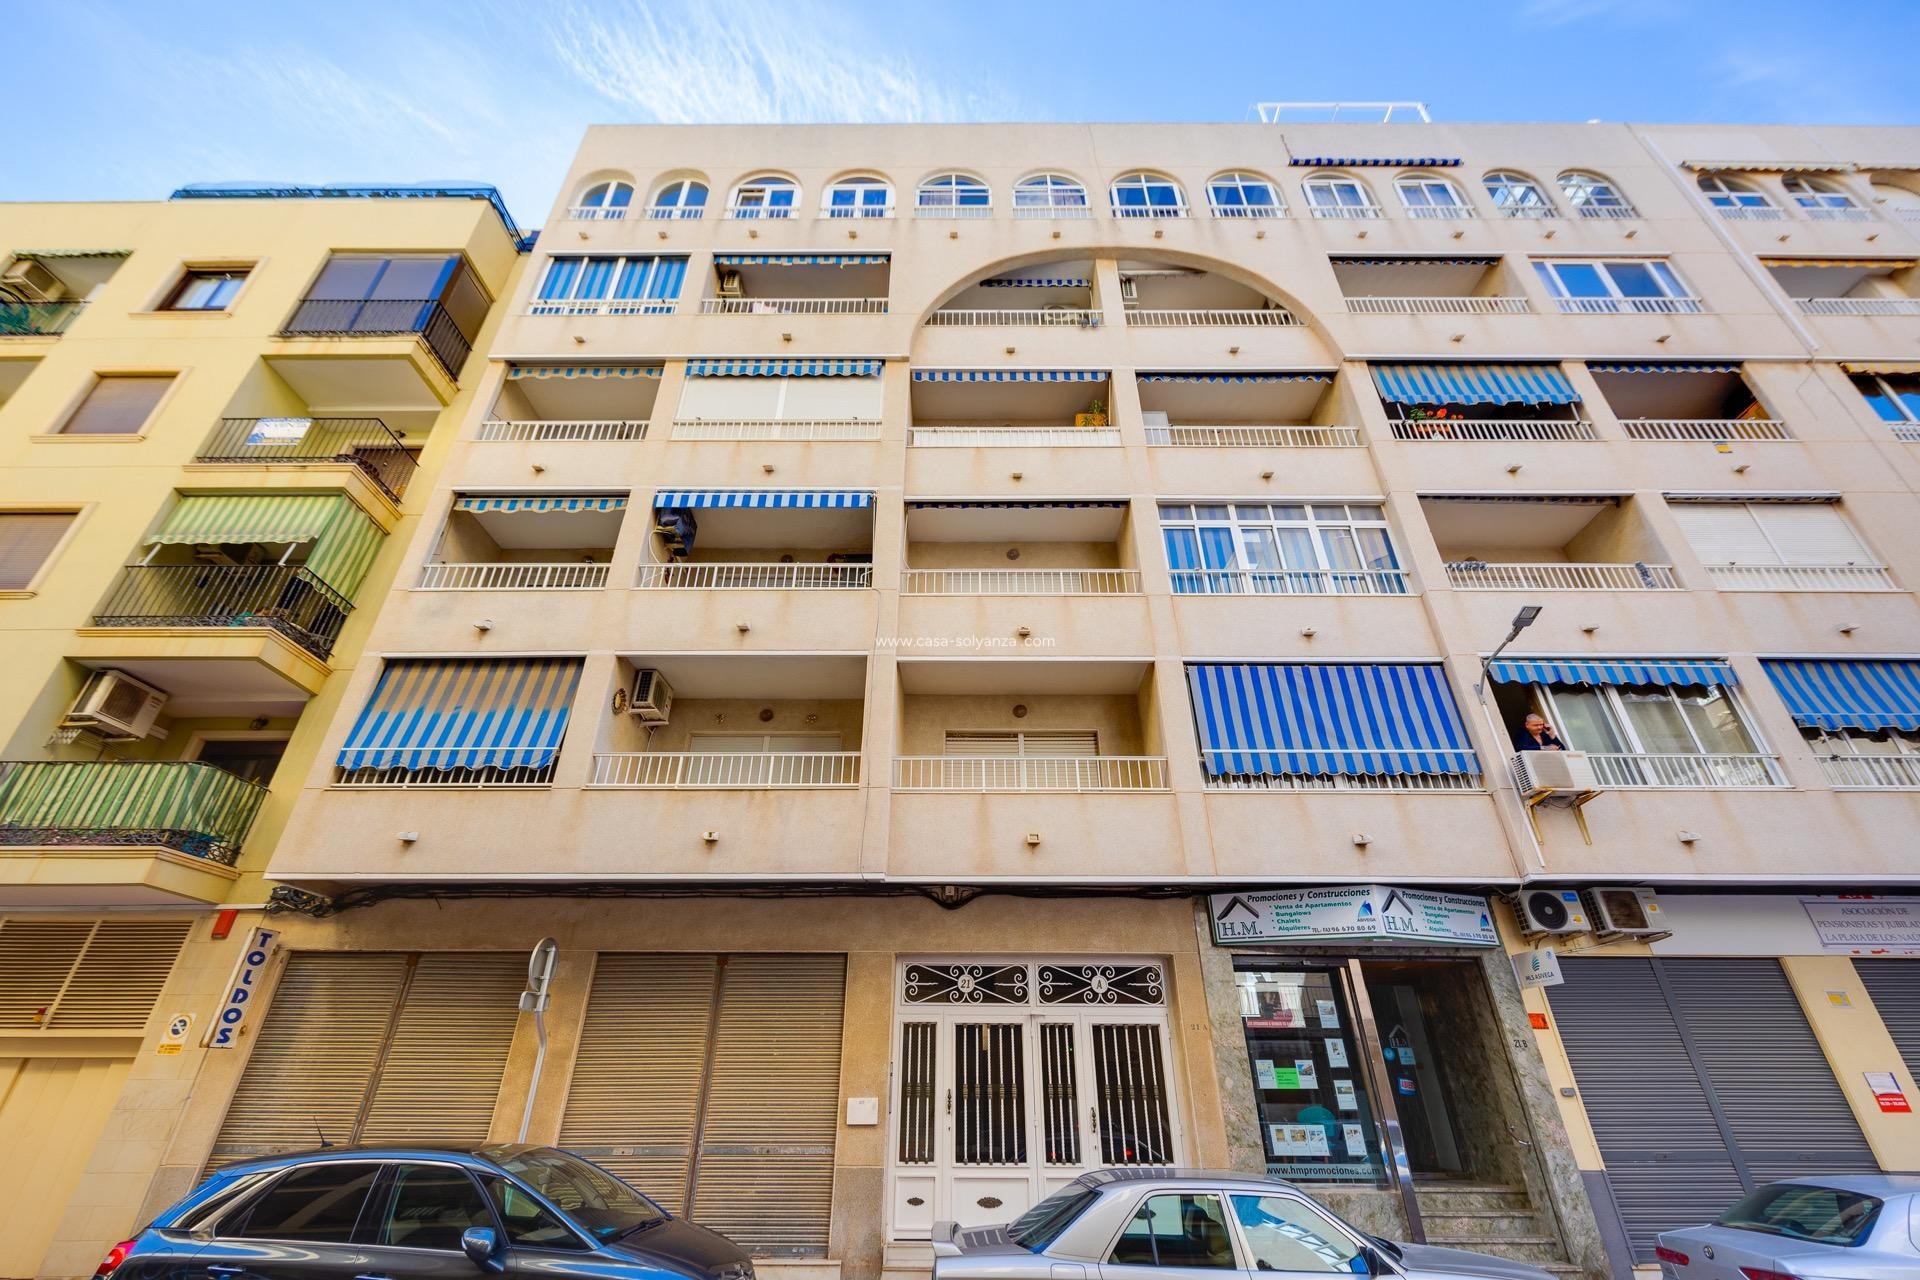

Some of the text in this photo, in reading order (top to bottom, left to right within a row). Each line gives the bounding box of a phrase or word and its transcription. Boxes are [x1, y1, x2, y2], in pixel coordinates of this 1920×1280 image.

[1247, 889, 1371, 903] Promociones y Construcciones
[1402, 891, 1438, 902] Promociones
[1444, 896, 1486, 907] Construcciones
[1221, 921, 1263, 936] H.M.
[1384, 915, 1418, 932] H.M.
[1817, 920, 1877, 928] PENSIONISTAS
[216, 933, 273, 1044] TOLDOS
[960, 979, 970, 989] 21
[1096, 980, 1103, 989] A
[1266, 1165, 1380, 1176] www.hmpromociones.com
